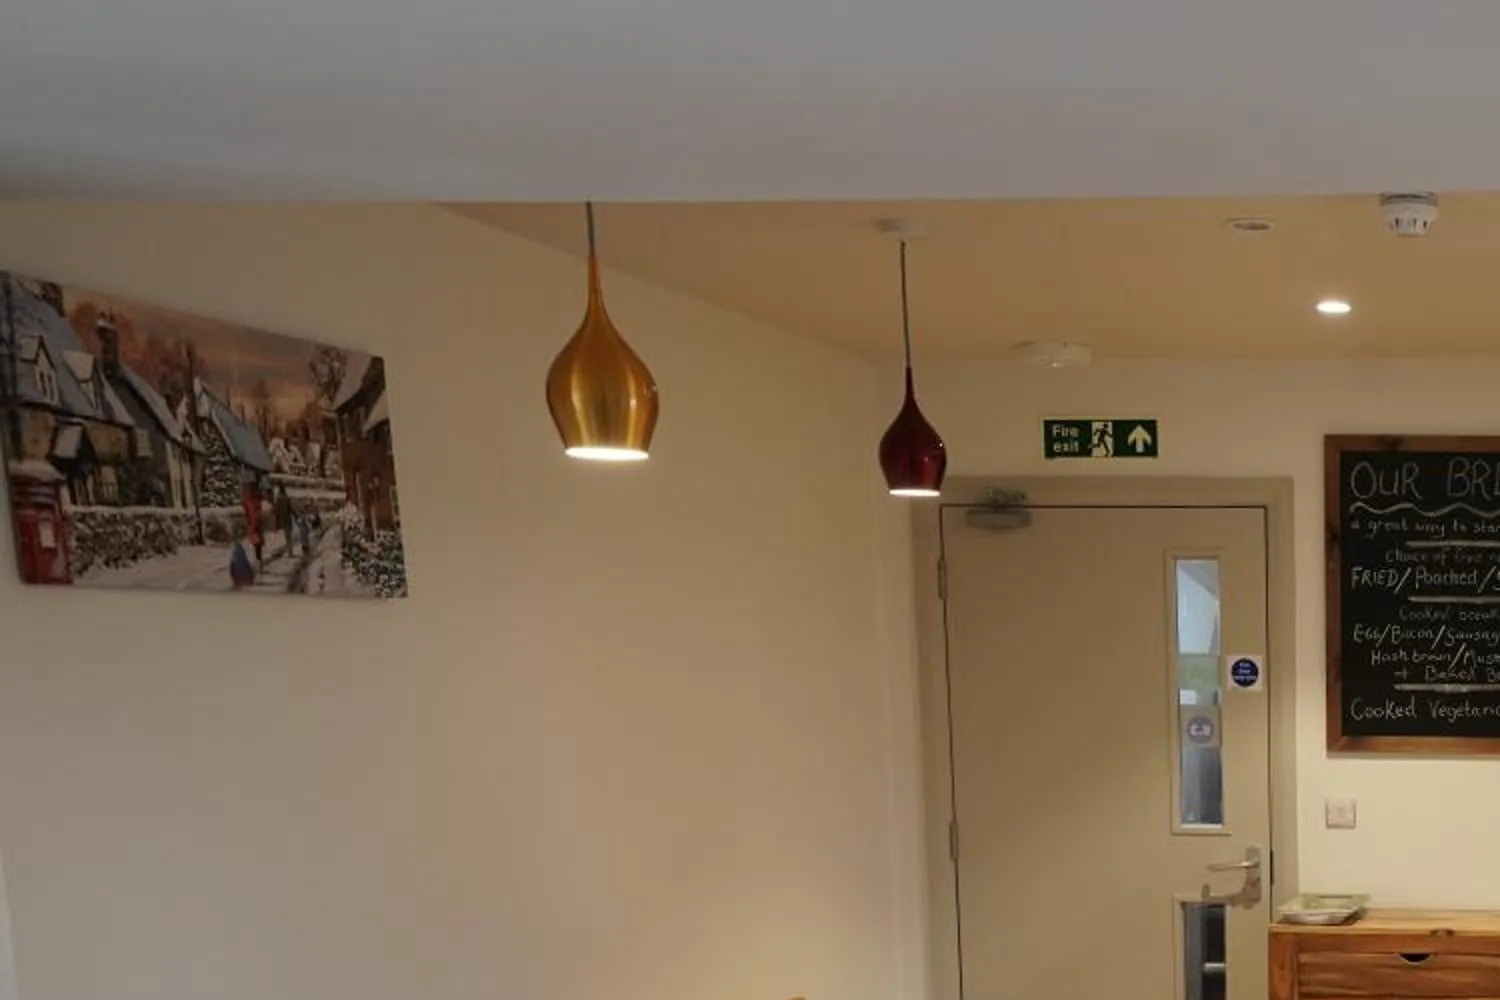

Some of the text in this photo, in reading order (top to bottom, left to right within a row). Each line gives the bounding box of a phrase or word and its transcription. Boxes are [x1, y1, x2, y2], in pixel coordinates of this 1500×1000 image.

[1051, 424, 1080, 438] Fire
[1053, 440, 1080, 453] exit
[1350, 460, 1422, 501] OUR
[1363, 517, 1408, 540] great
[1350, 695, 1418, 721] Cooked
